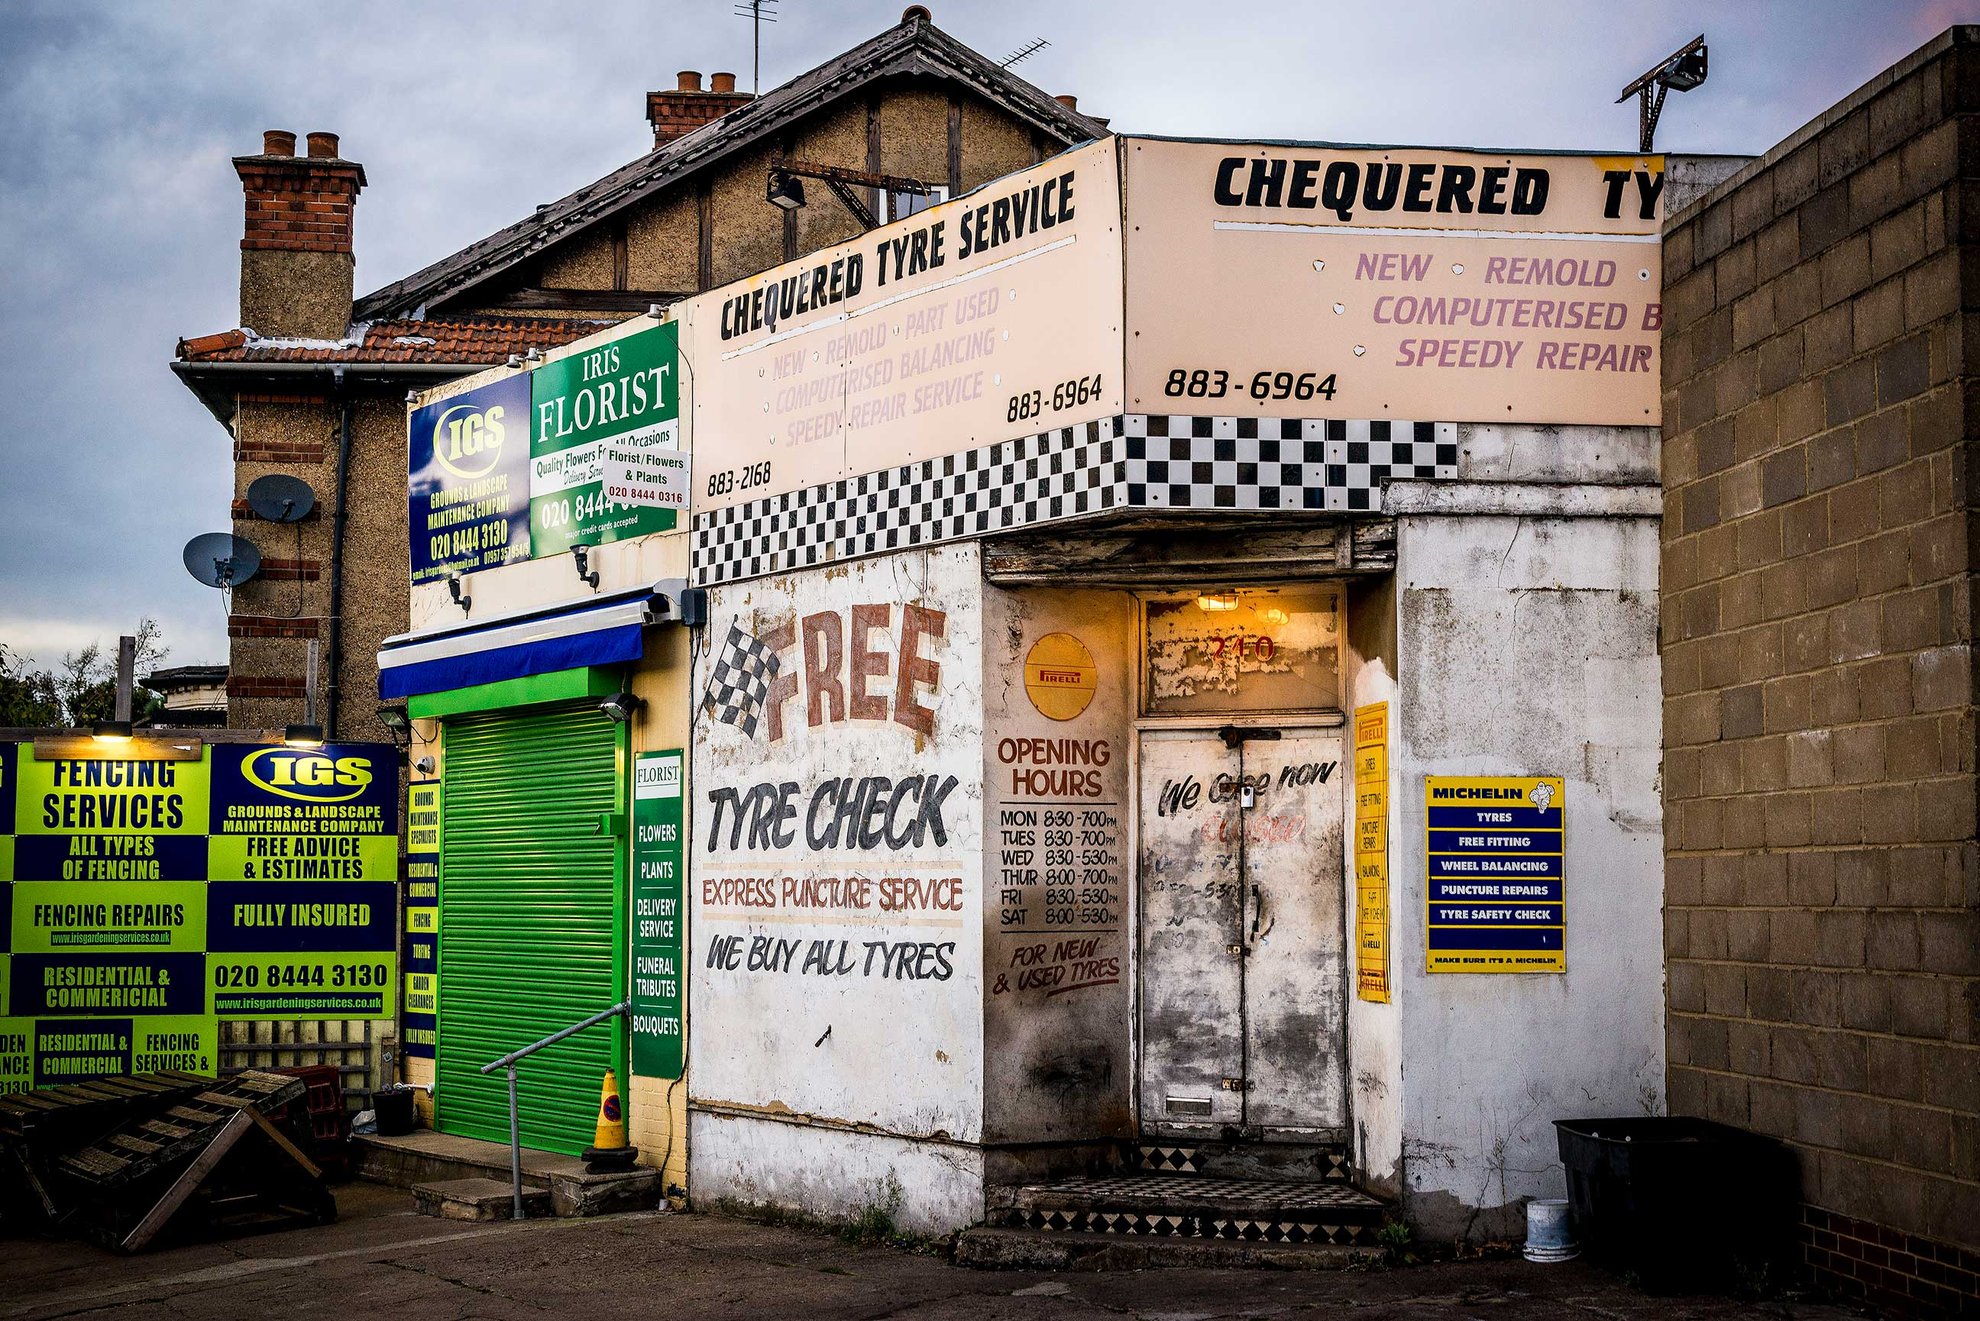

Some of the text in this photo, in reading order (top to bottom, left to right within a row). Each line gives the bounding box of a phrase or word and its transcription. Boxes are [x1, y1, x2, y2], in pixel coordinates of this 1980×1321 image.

[1213, 156, 1550, 222] CHEQUERED
[720, 170, 1076, 341] CHEQUERED TYRE SERVICE
[1355, 252, 1617, 288] NEW REMOLD
[1373, 295, 1628, 331] COMPUTERISED
[773, 287, 999, 381] NEW REMOLD PART USED
[1395, 338, 1524, 369] SPEEDY
[583, 346, 619, 382] IRIS
[775, 328, 996, 416] COMPUTERISED BALANCING
[538, 363, 670, 443] FLORIST
[1007, 374, 1102, 423] 883-6964
[786, 370, 984, 448] SPEEDY REPAIR SERVICE
[449, 405, 505, 461] IGS
[537, 451, 596, 479] Quality Flowers
[609, 450, 684, 469] Florist/Flowers
[626, 469, 667, 485] & Plants
[707, 461, 771, 498] 883-2168
[430, 485, 462, 509] GROUNDS
[470, 474, 508, 500] LANDSCAPE
[609, 486, 682, 503] 020 8444 0316
[428, 495, 510, 530] MAINTENANCE COMPANY
[542, 498, 570, 529] 020
[565, 514, 638, 541] major credit cards accepted
[430, 519, 508, 561] 020 8444 3130
[757, 603, 947, 743] FREE
[1040, 669, 1081, 683] PIRELLI
[1359, 717, 1384, 743] PIRELLI
[998, 737, 1110, 767] OPENING
[54, 761, 175, 787] FENCING
[270, 757, 373, 785] IGS
[638, 765, 679, 783] FLORIST
[1013, 768, 1102, 797] HOURS
[1158, 760, 1337, 817] We now
[1433, 787, 1523, 800] MICHELIN
[43, 794, 183, 829] SERVICES
[228, 806, 381, 818] GROUNDS & LANDSCAPE
[708, 774, 960, 853] TYRE CHECK
[1001, 811, 1037, 826] MON
[1477, 812, 1512, 822] TYRES
[223, 820, 384, 833] MAINTENANCE COMPANY
[639, 824, 676, 842] FLOWERS
[1362, 820, 1378, 835] PUNCTURE
[69, 836, 154, 856] ALL TYPES
[247, 837, 360, 857] FREE ADVICE
[1001, 830, 1035, 846] TUES
[1459, 837, 1531, 847] FREE FITTING
[1001, 850, 1034, 866] WED
[1441, 861, 1548, 871] WHEEL BALANCING
[62, 860, 159, 879] OF FENCING
[244, 859, 363, 879] & ESTIMATES
[641, 861, 673, 879] PLANTS
[1001, 869, 1038, 886] THUR
[703, 876, 963, 912] EXPRESS PUNCTURE SERVICE
[1001, 889, 1022, 905] FRI
[1441, 885, 1548, 895] PUNCTURE REPAIRS
[34, 903, 184, 927] FENCING REPAIRS
[234, 903, 370, 927] FULLY INSURED
[637, 899, 676, 916] DELIVERY
[1001, 909, 1028, 925] SAT
[1440, 909, 1551, 920] TYRE SAFETY CHECK
[414, 913, 431, 927] FENCING
[640, 920, 673, 937] SERVICE
[52, 931, 170, 945] www.irisgardeningservices.co.uk
[413, 944, 431, 959] TURFING
[706, 934, 956, 981] WE BUY ALL TYRES
[1010, 937, 1100, 968] FOR NEW
[1515, 957, 1557, 965] MICHELIN
[44, 966, 170, 986] RESIDENTIAL &
[215, 964, 387, 987] 020 8444 3130
[637, 957, 675, 975] FUNERAL
[993, 957, 1120, 995] & USED TYRES
[413, 975, 429, 990] GARDEN
[637, 979, 676, 997] TRIBUTES
[46, 987, 167, 1007] COMMERICIAL
[216, 996, 382, 1009] www.irisgardeningservices.co.uk
[633, 1015, 679, 1036] BOUQUETS
[39, 1033, 128, 1052] RESIDENTIAL &
[147, 1033, 200, 1051] FENCING
[406, 1028, 417, 1044] FULLY
[43, 1056, 123, 1075] COMMERCIAL
[136, 1054, 209, 1072] SERVICES &
